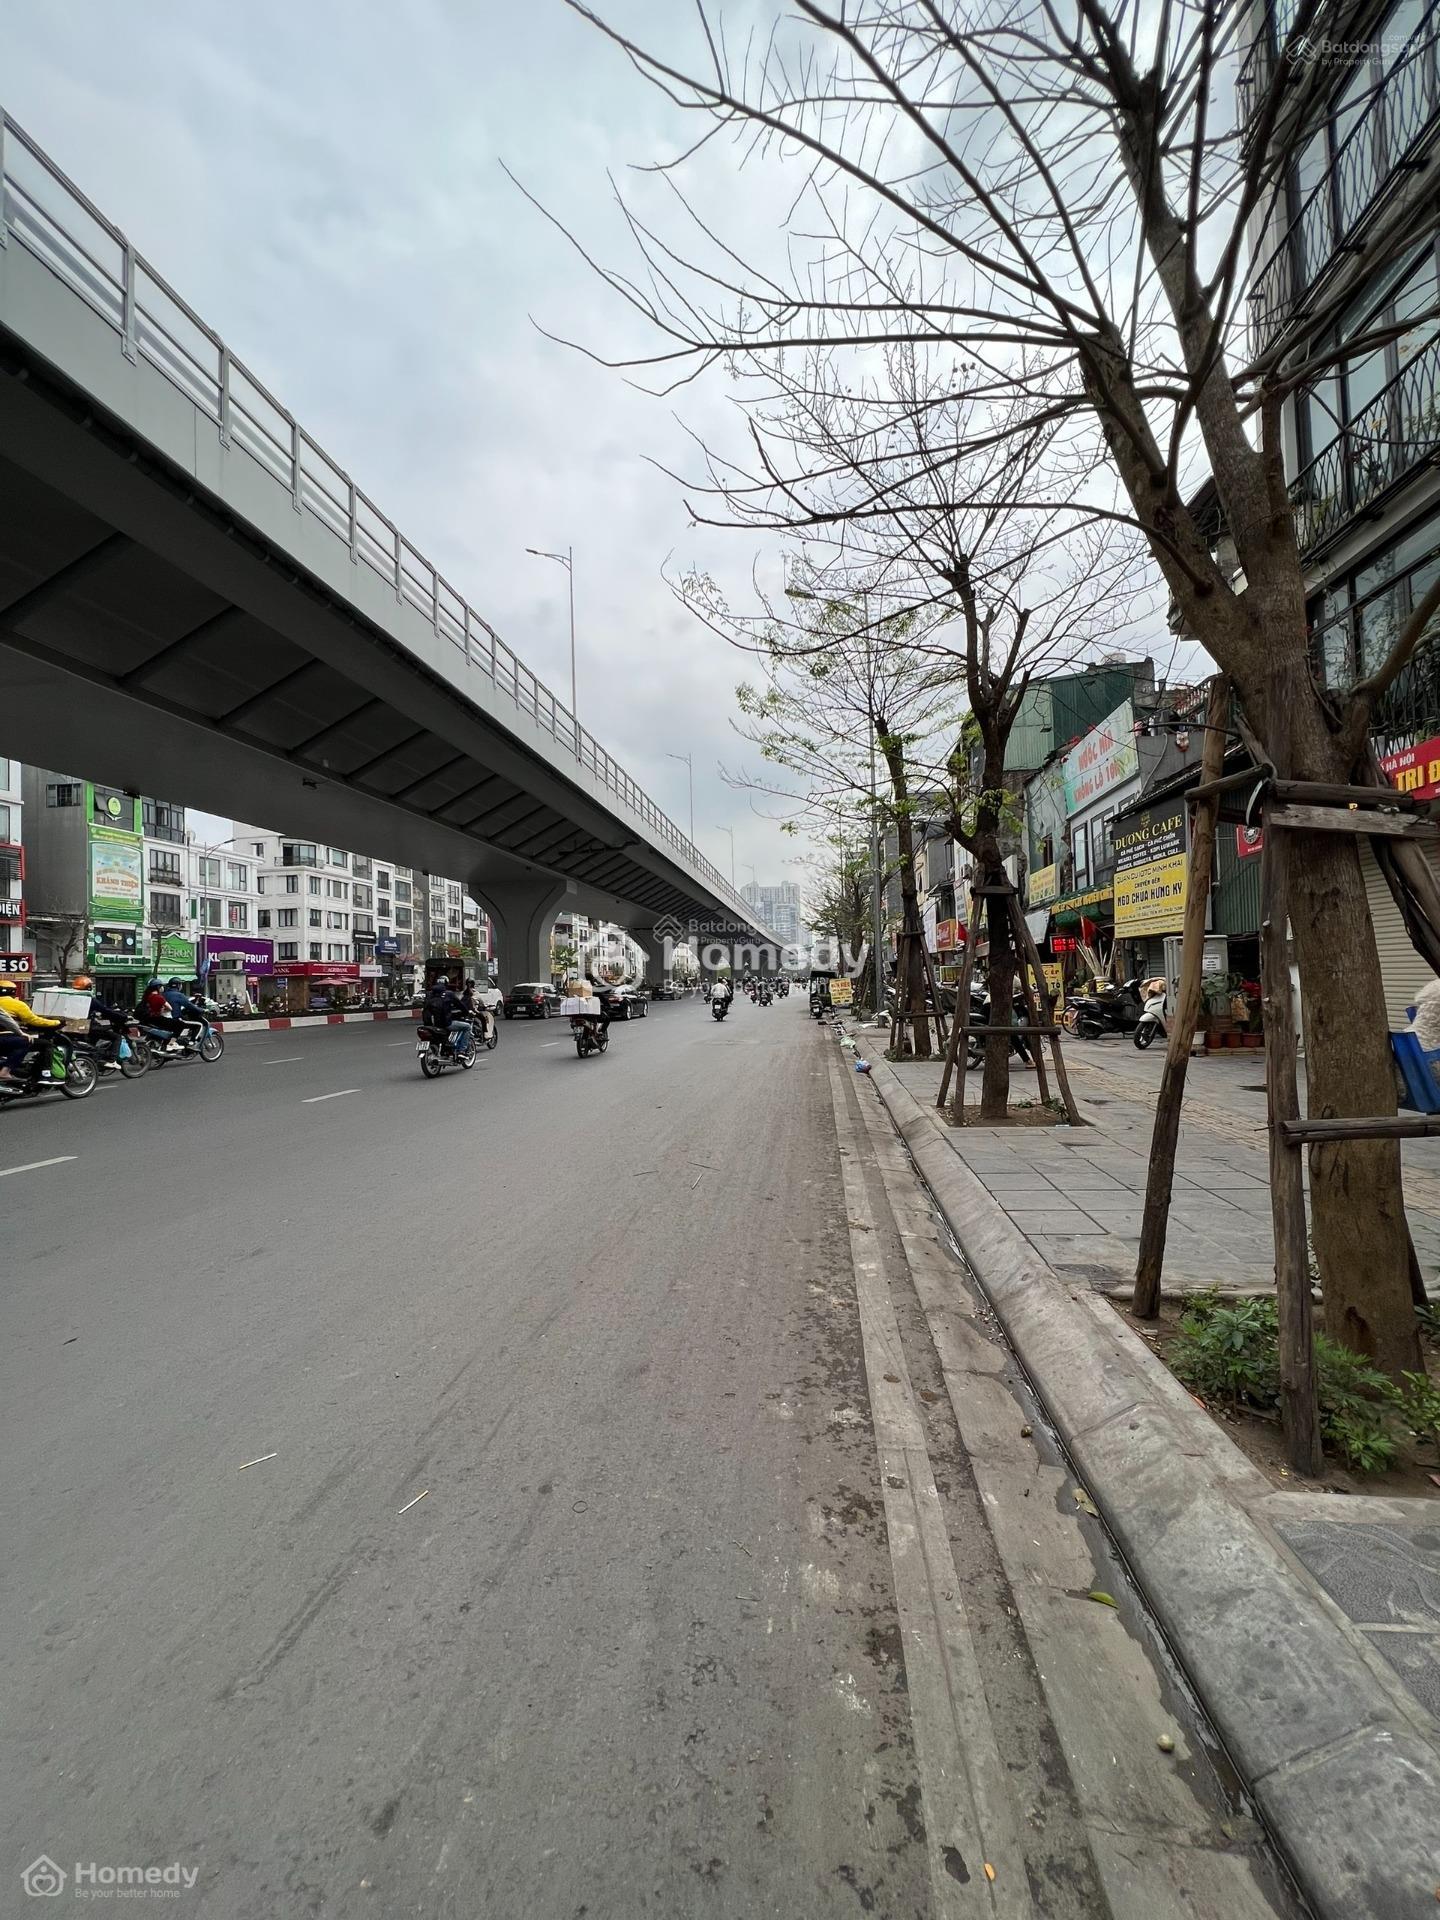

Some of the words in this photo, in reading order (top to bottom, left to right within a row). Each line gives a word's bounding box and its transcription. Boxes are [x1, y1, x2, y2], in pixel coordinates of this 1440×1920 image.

[1395, 765, 1424, 792] TRI
[1152, 815, 1183, 836] CAFE
[10, 956, 29, 972] SỐ
[245, 954, 269, 964] FRUIT
